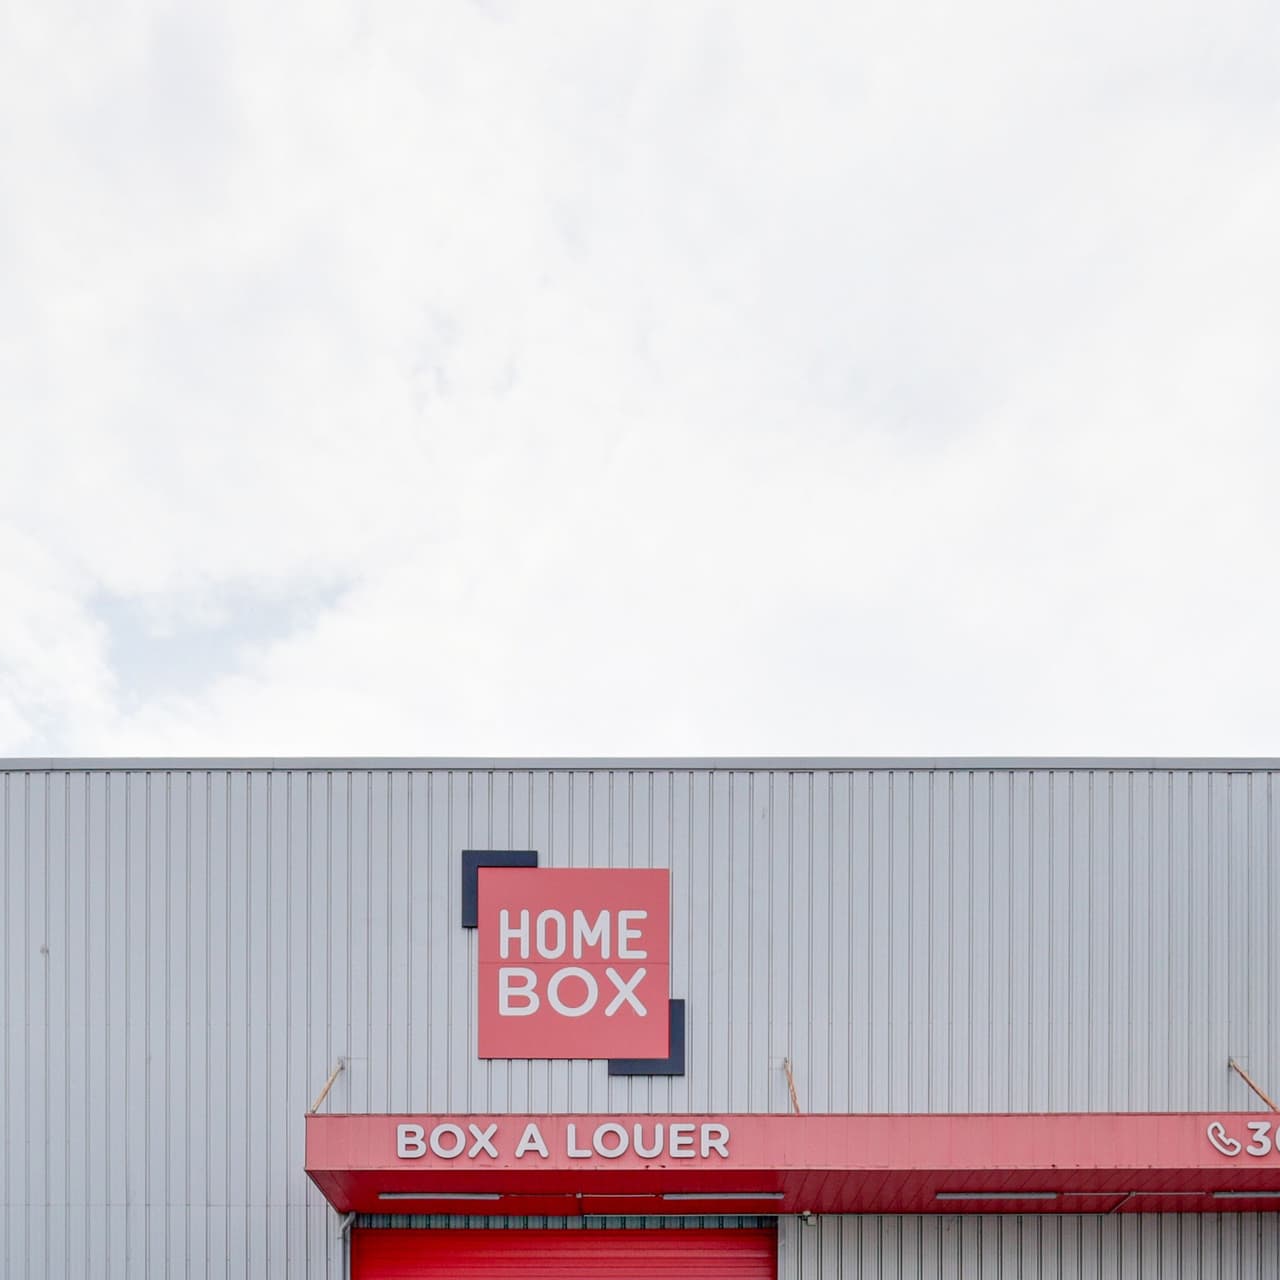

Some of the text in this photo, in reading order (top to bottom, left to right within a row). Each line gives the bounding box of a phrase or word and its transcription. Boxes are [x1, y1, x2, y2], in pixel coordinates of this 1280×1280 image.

[499, 909, 647, 959] HOME
[499, 967, 647, 1017] BOX
[396, 1122, 730, 1159] BOX A LOUER
